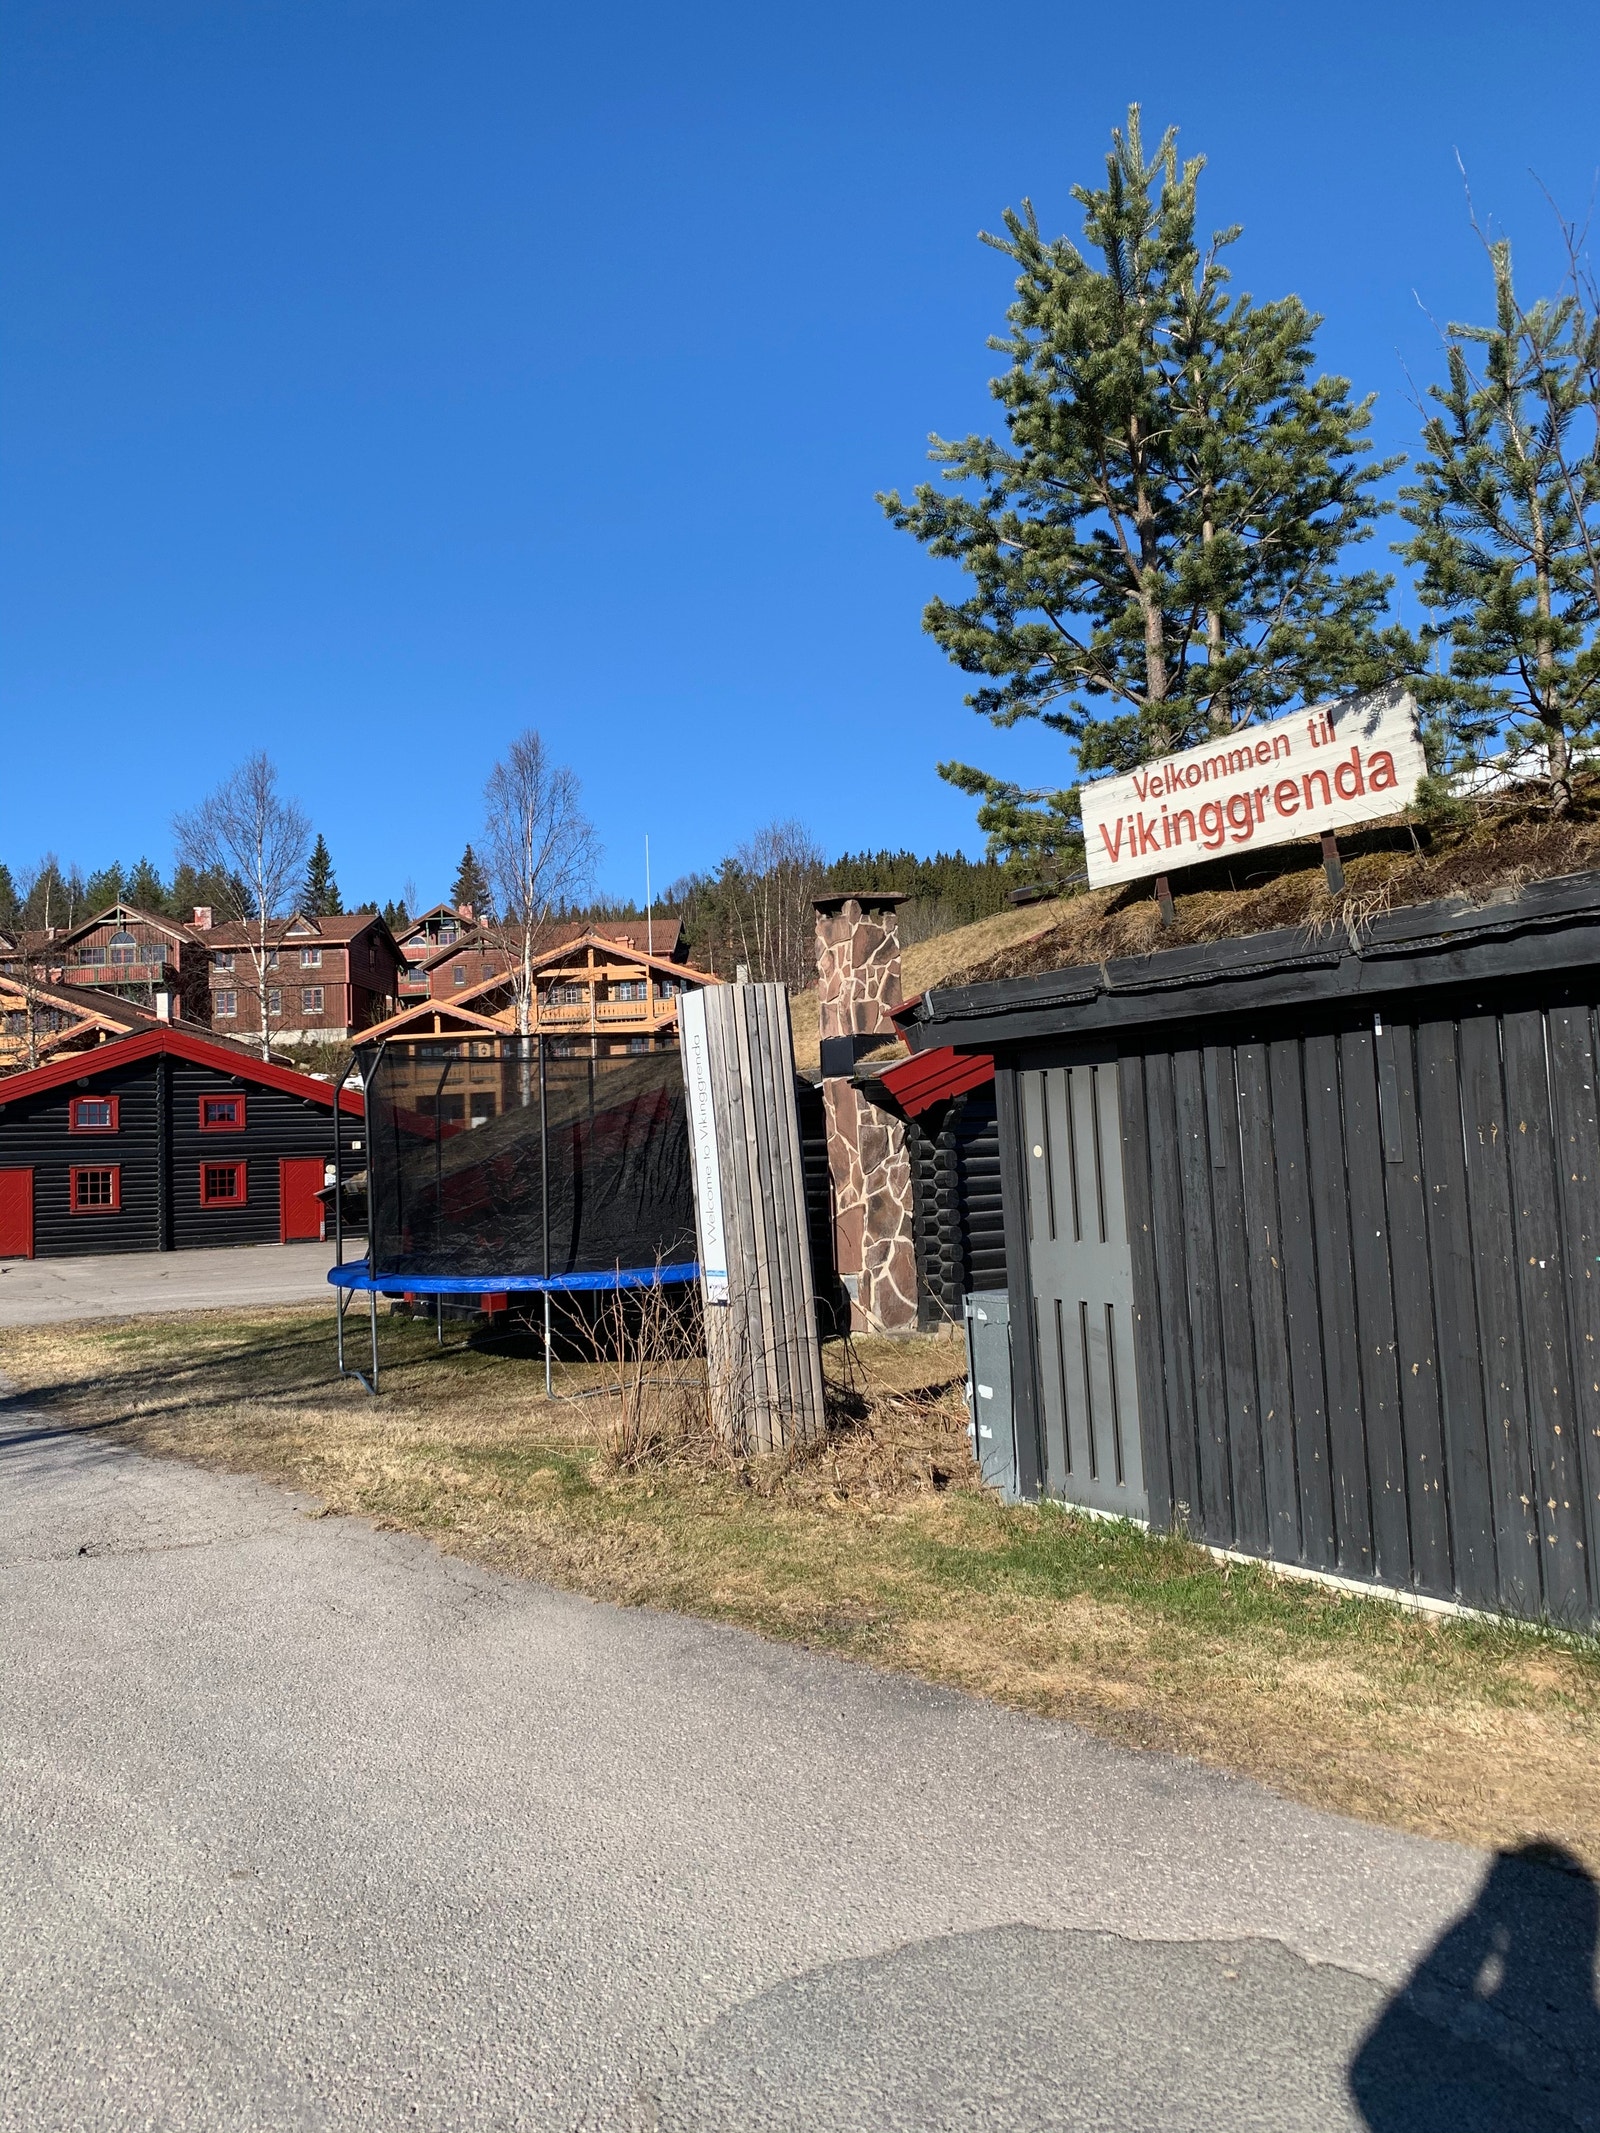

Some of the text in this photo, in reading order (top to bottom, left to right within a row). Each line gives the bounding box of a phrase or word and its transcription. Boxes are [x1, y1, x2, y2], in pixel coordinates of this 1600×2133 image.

[1099, 746, 1399, 863] Vikinggrenda
[1132, 709, 1337, 802] Velkommen til
[691, 1034, 717, 1245] Welcome to Vikinggrenda
